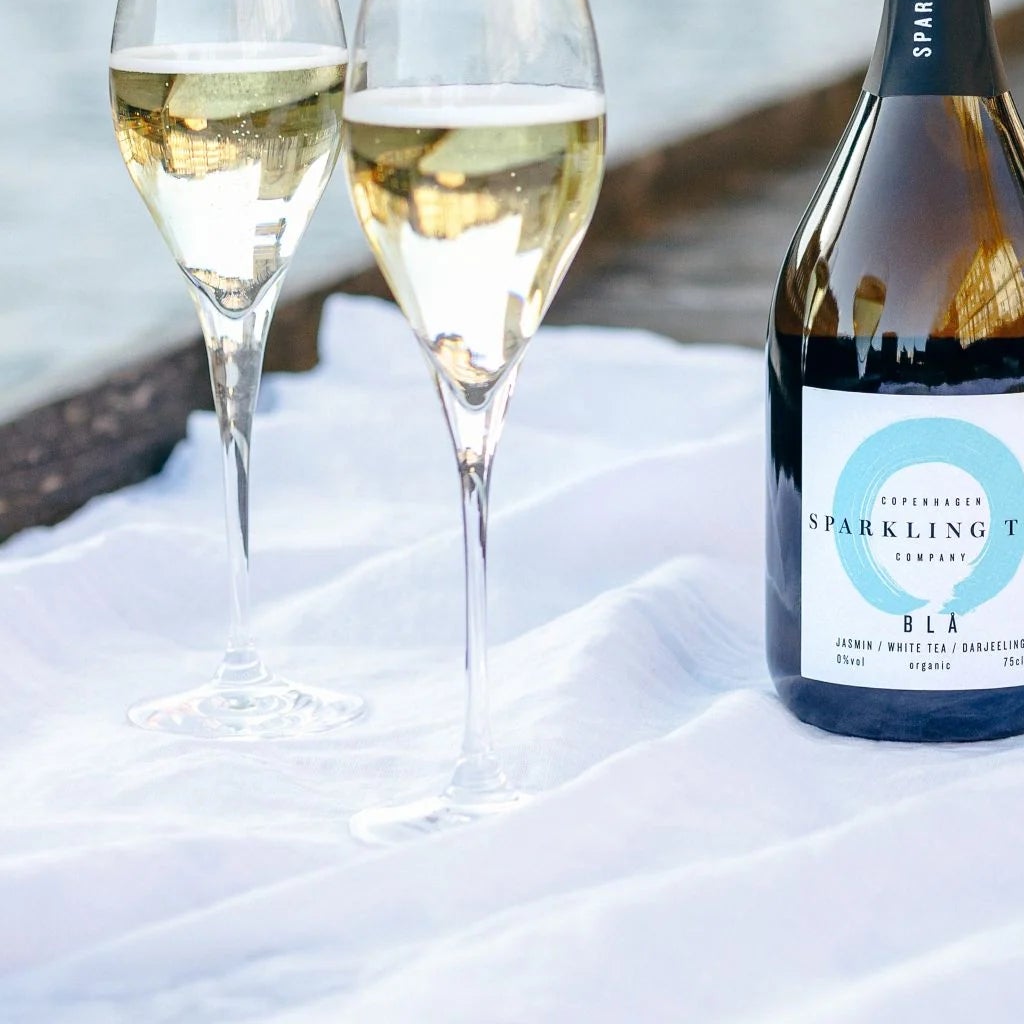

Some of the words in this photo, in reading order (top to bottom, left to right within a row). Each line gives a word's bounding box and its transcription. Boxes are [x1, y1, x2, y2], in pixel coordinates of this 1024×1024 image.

[881, 496, 981, 507] COPENHAGEN
[809, 513, 986, 539] SPARKLING
[895, 552, 966, 562] COMPANY
[903, 611, 958, 634] BLÅ
[835, 638, 872, 650] JASMIN
[887, 641, 921, 653] WHITE
[927, 643, 946, 654] TEA
[962, 638, 1024, 653] DARJEELING
[836, 654, 865, 666] 0%vol
[909, 660, 951, 672] organic
[1003, 655, 1024, 667] 75cl
